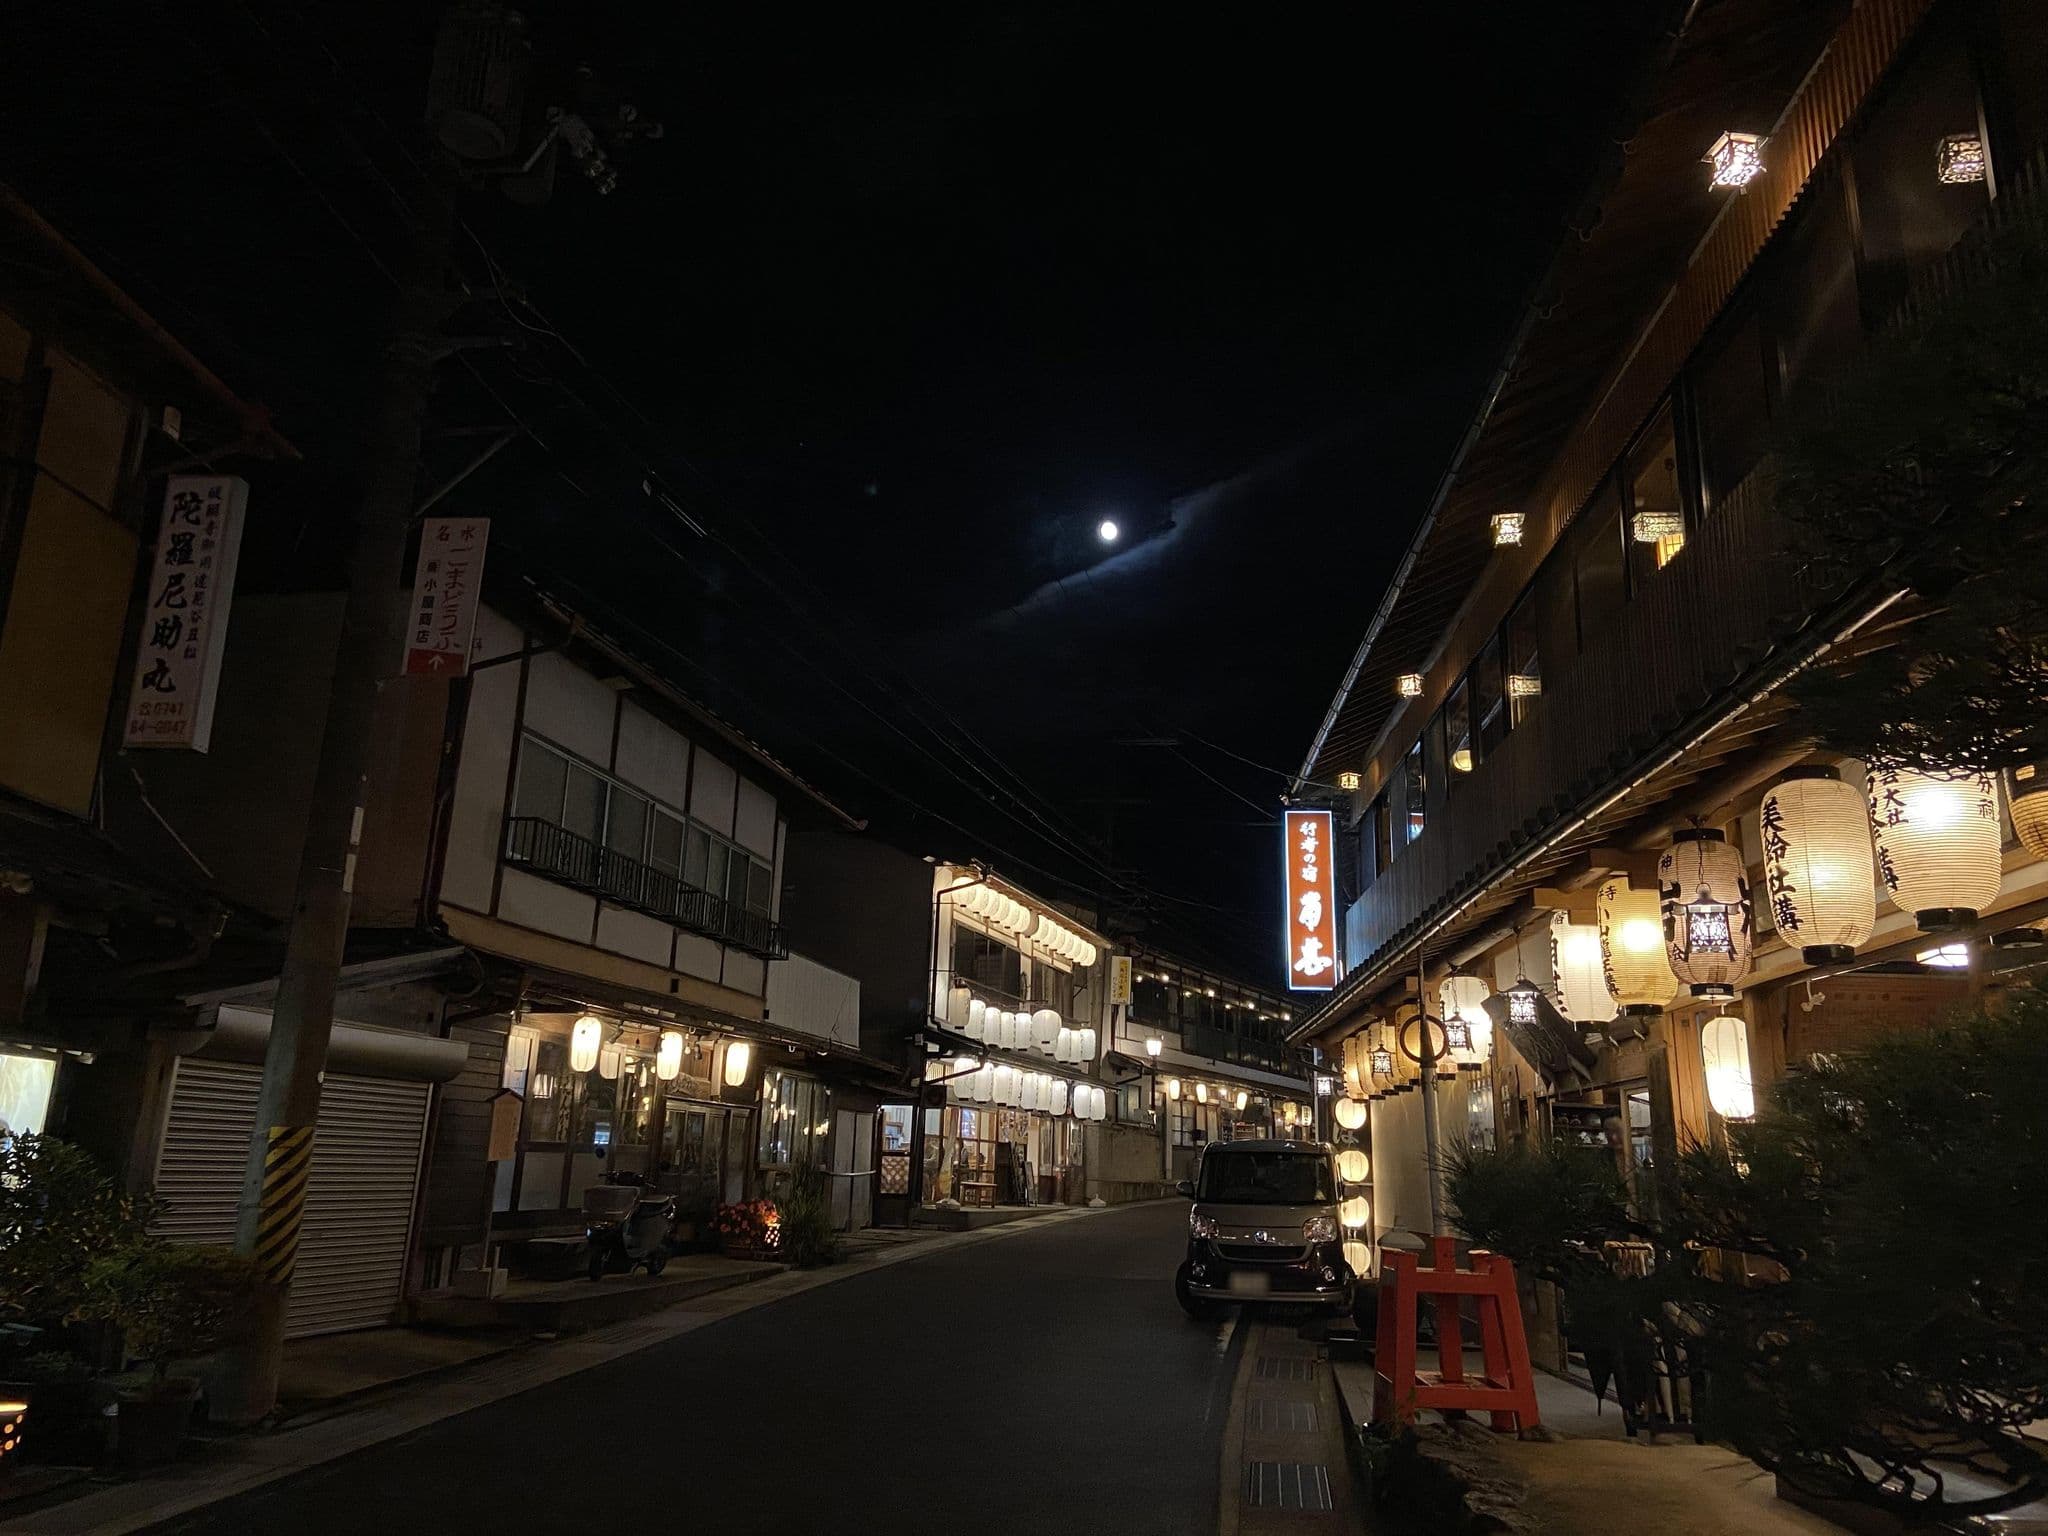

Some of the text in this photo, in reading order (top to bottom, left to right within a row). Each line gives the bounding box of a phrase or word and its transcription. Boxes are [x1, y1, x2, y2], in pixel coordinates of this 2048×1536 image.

[141, 491, 203, 693] 陀羅尼助丸
